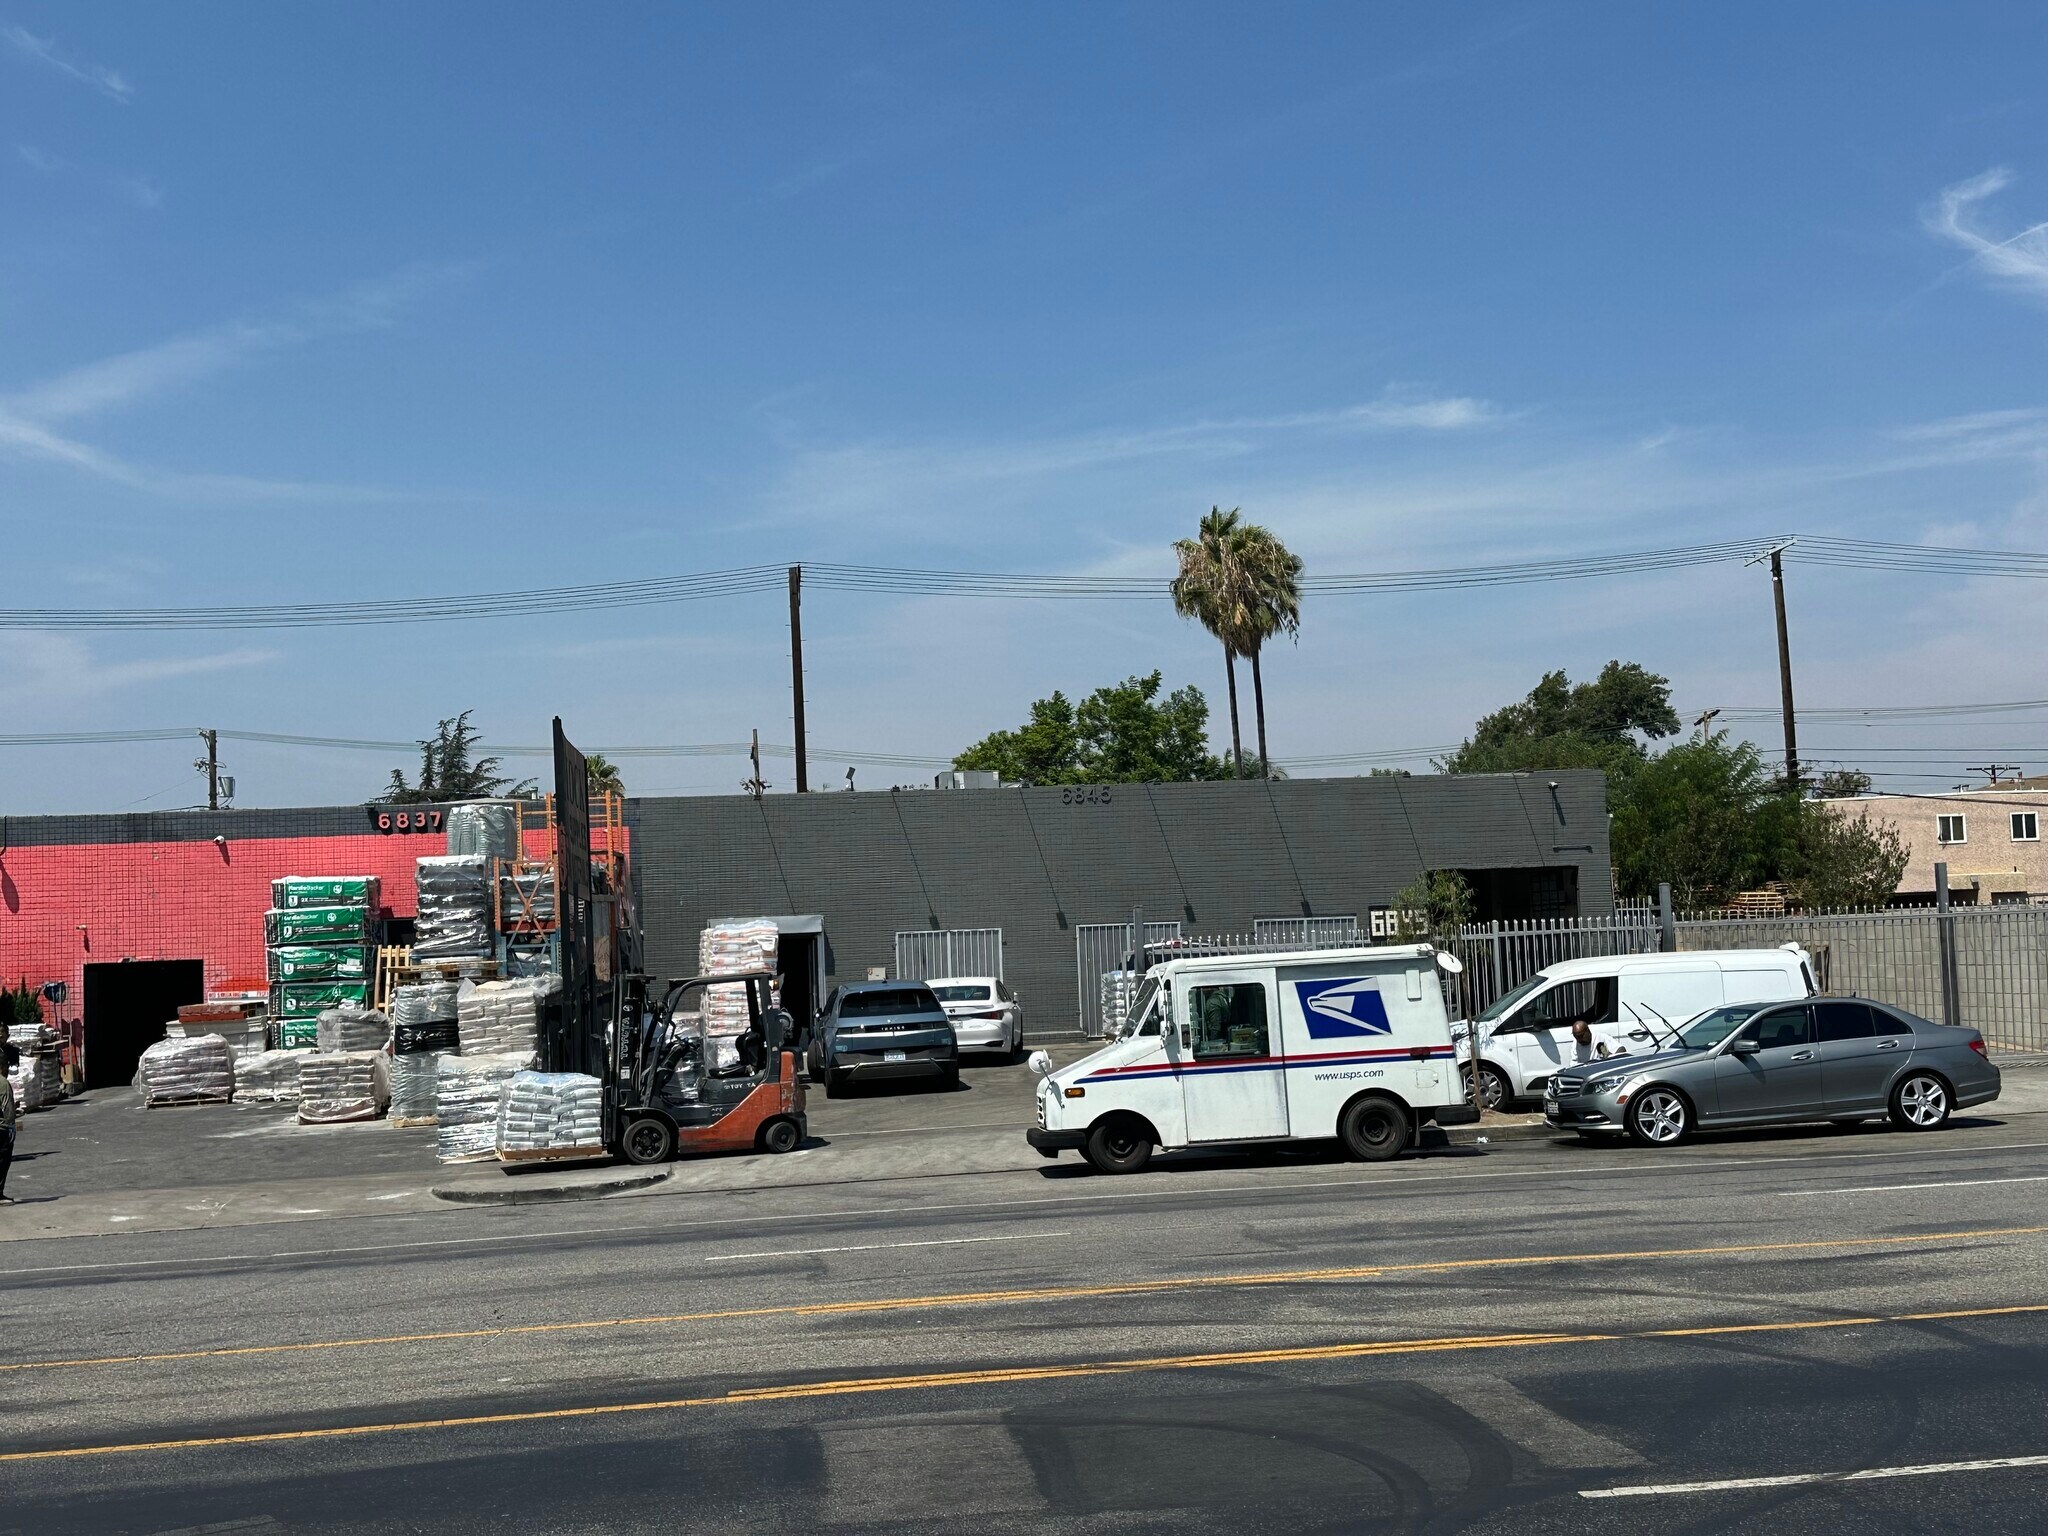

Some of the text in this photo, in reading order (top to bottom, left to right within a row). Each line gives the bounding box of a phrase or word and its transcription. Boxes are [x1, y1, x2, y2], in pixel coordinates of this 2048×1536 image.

[1061, 786, 1112, 805] 6845
[378, 811, 441, 829] 6837
[1314, 1069, 1384, 1081] www.usps.com
[730, 1082, 756, 1090] TOYTA
